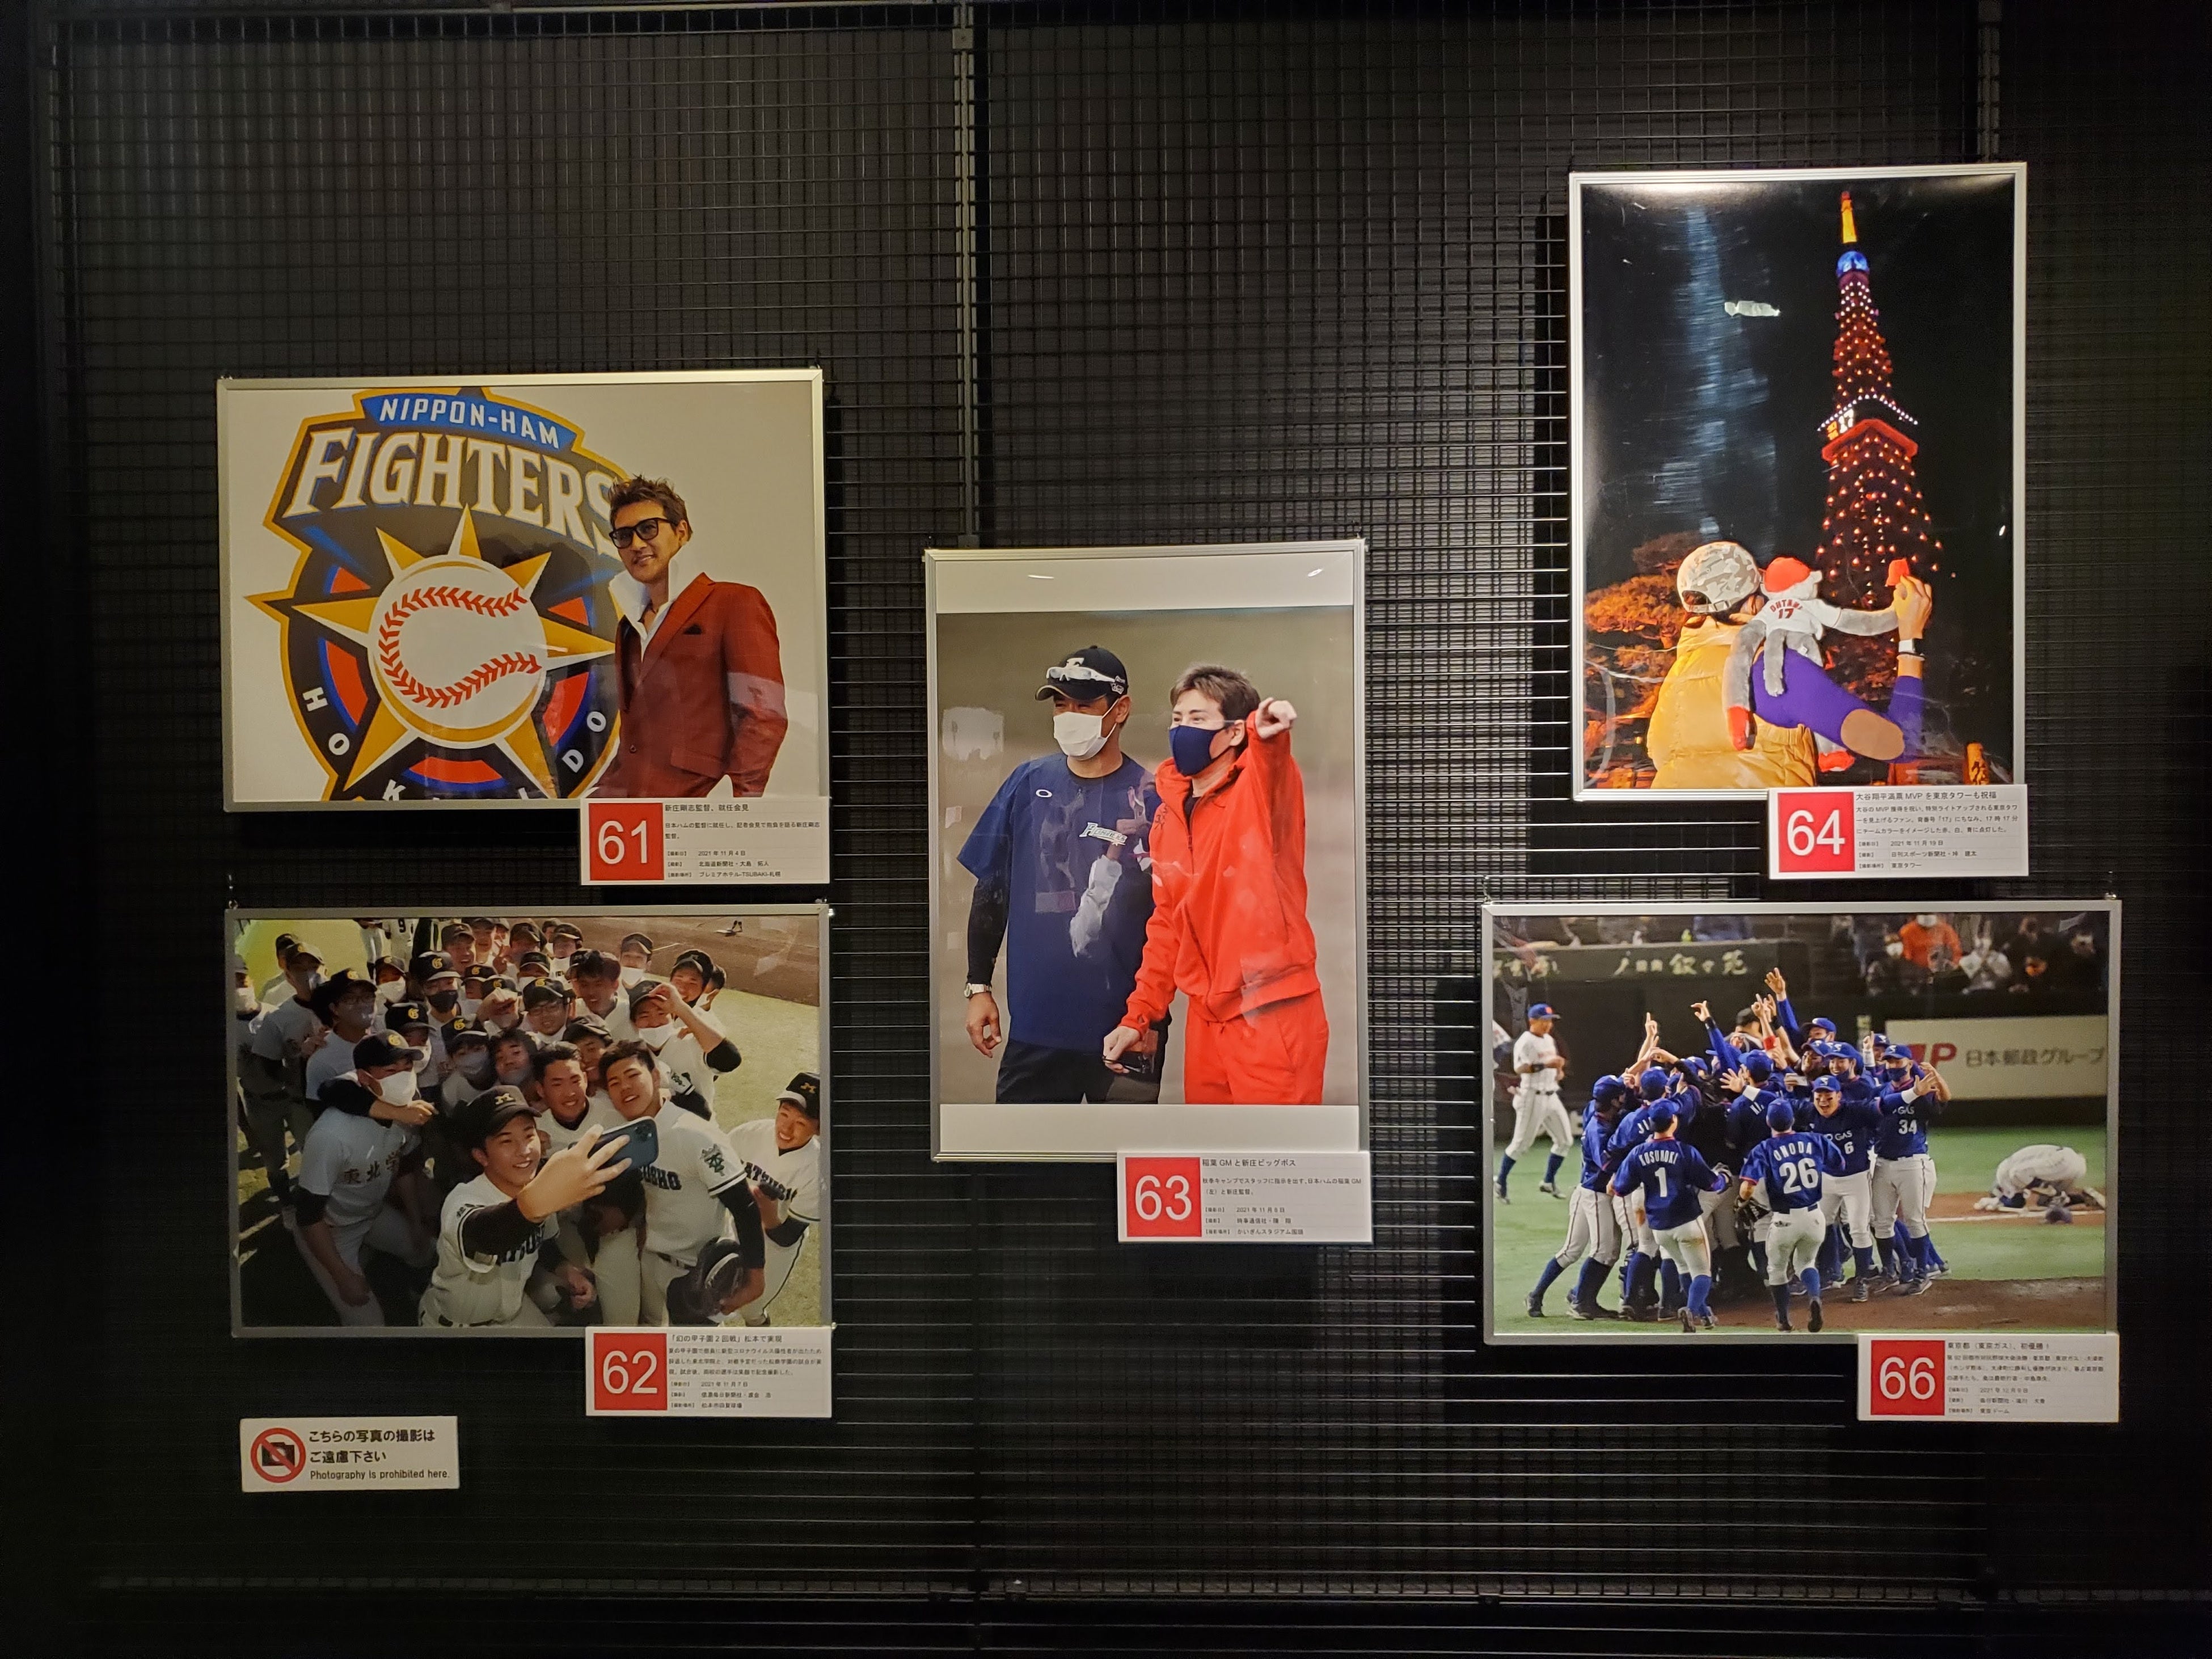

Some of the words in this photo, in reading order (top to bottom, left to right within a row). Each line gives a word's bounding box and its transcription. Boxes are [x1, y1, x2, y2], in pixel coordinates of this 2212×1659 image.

[379, 398, 559, 449] NIPPON-HAM
[1778, 608, 1794, 619] 17
[598, 820, 648, 864] 61
[1787, 809, 1846, 856] 64
[1898, 1120, 1917, 1134] 34
[1844, 1142, 1854, 1154] 6
[1654, 1167, 1668, 1197] 1
[1779, 1158, 1818, 1194] 26
[1135, 1175, 1192, 1221] 63
[602, 1350, 658, 1394] 62
[1879, 1357, 1936, 1399] 66
[309, 1429, 435, 1442] こちらの写真の撮影は
[309, 1451, 387, 1464] ご遠慮下さい
[310, 1470, 365, 1481] Photography
[369, 1470, 377, 1479] is
[379, 1470, 424, 1480] prohibited
